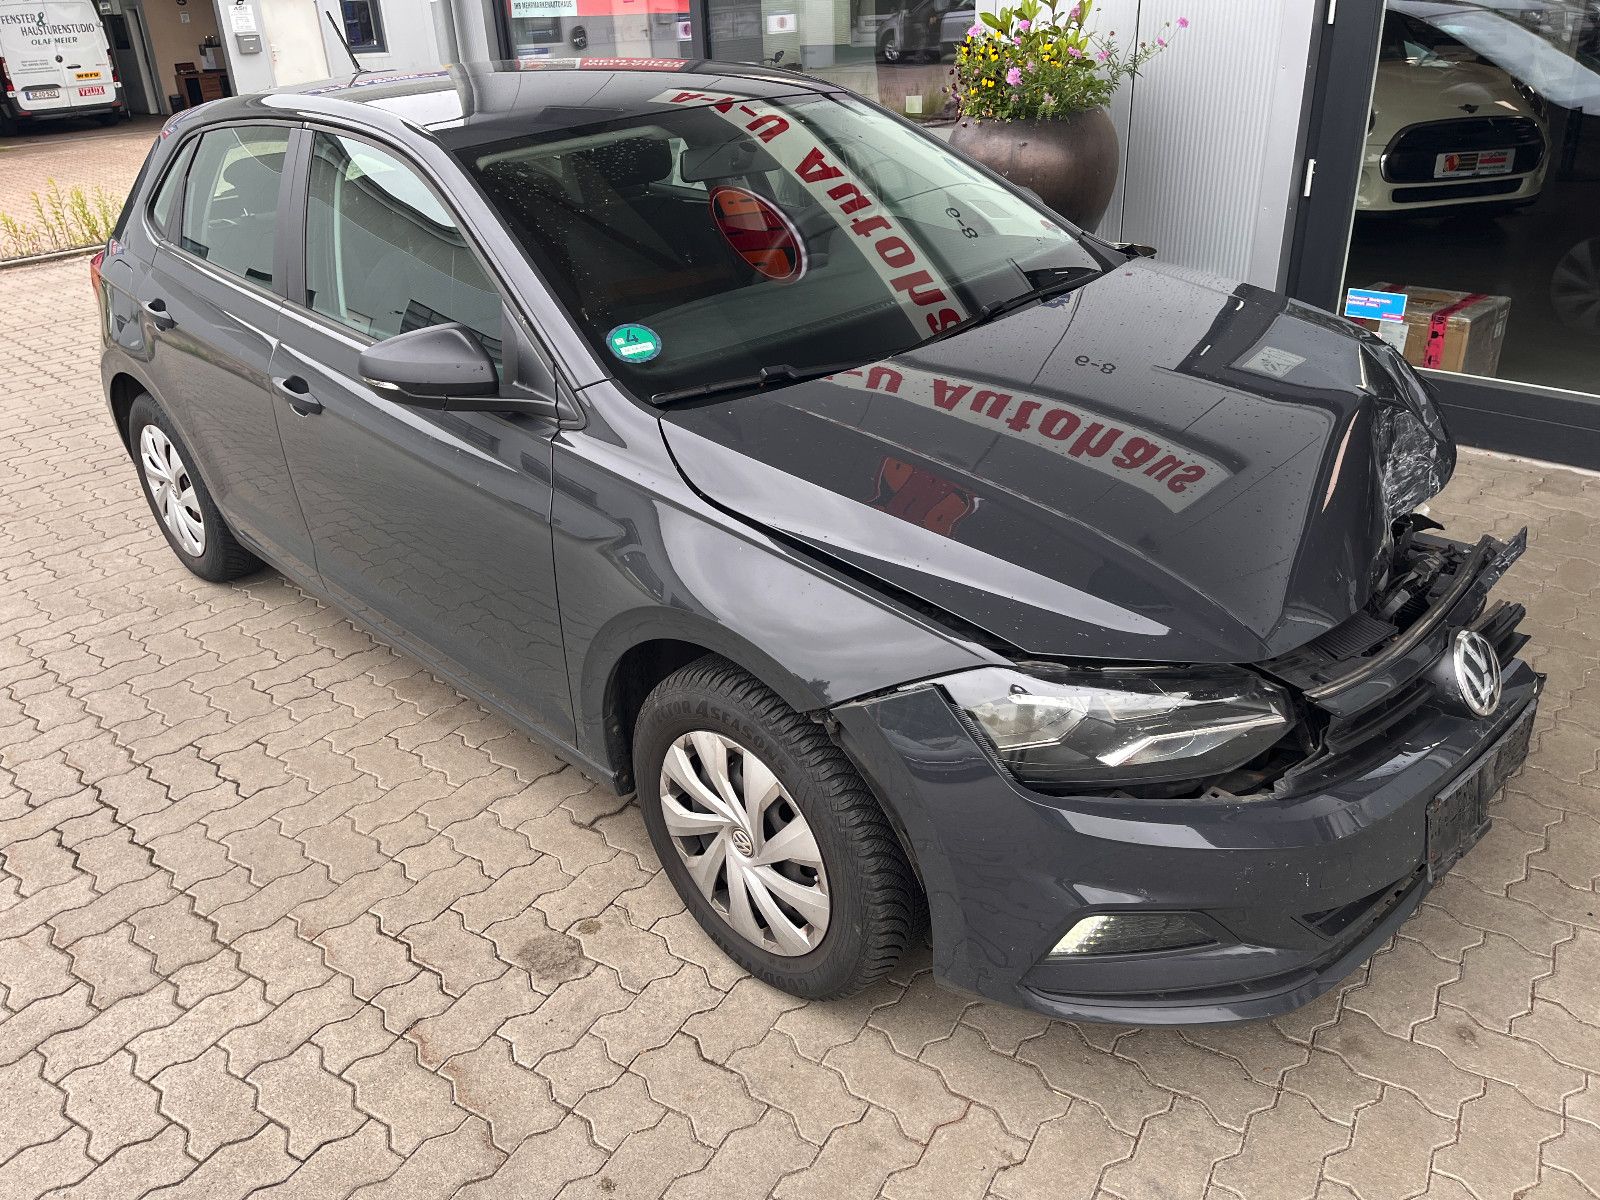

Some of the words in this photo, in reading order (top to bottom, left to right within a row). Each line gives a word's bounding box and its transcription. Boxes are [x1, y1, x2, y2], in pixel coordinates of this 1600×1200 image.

[1, 14, 37, 25] FENSTER
[31, 38, 52, 46] OLAF
[79, 86, 105, 96] VELUX
